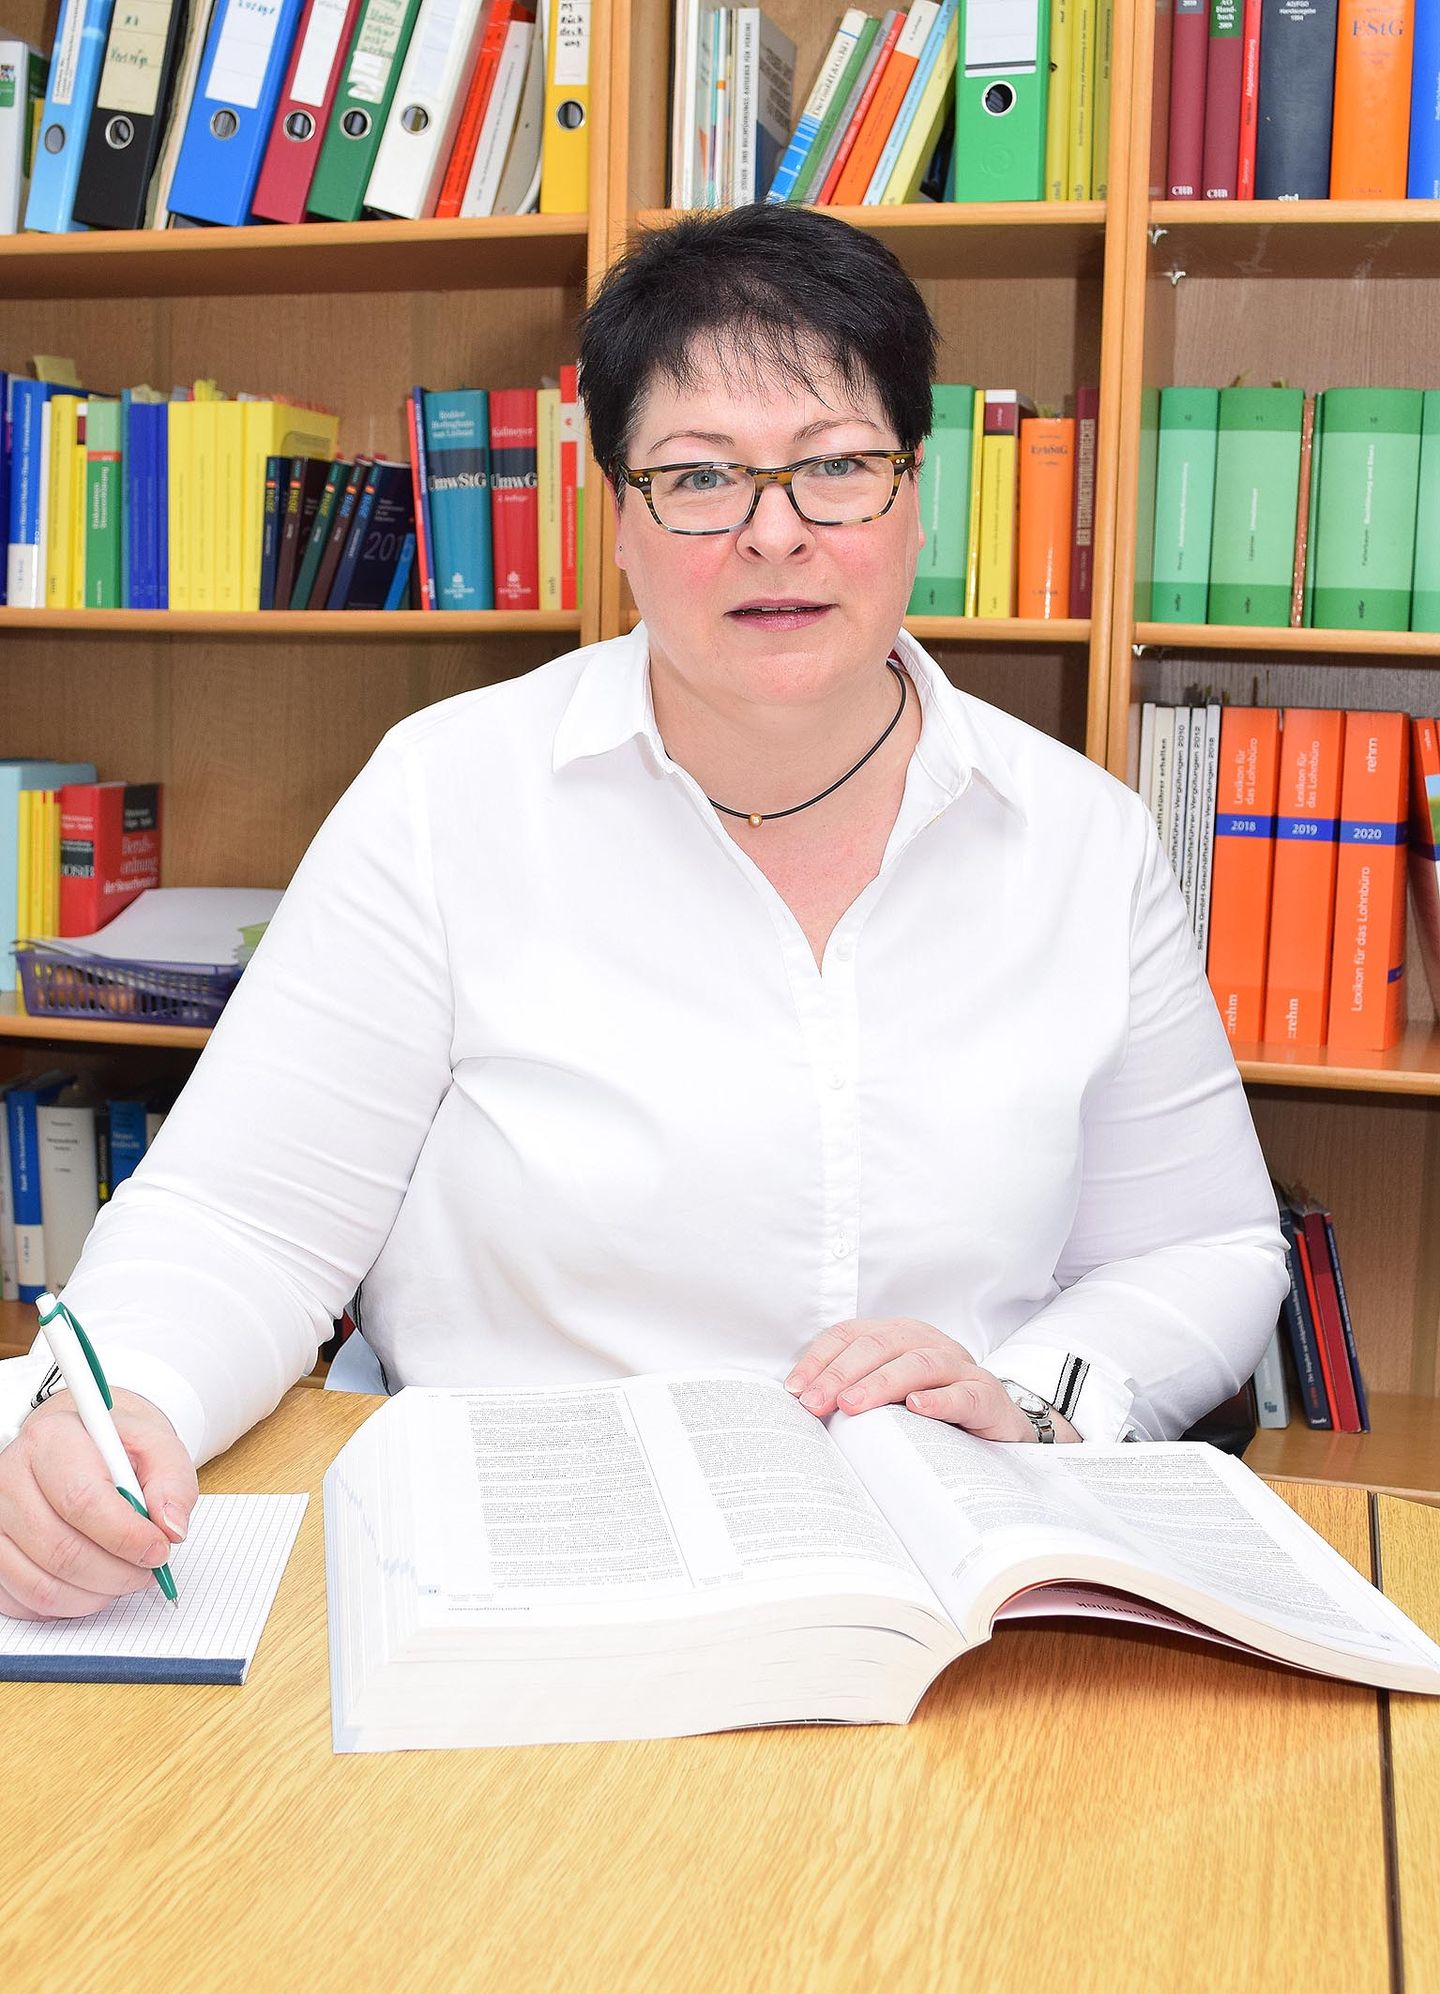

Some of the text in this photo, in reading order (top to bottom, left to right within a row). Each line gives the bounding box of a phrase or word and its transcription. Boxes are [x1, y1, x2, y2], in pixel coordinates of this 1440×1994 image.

[1351, 20, 1404, 36] EStG
[428, 472, 487, 490] UmwStG
[491, 472, 537, 489] UmwG
[1247, 737, 1258, 805] das Lohnbüro
[1366, 737, 1378, 772] rehm
[1234, 750, 1246, 804] Lexikon für
[1295, 752, 1306, 807] Lexikon für
[1307, 740, 1320, 808] das Lohnbüro
[1172, 750, 1184, 873] chäftsführer-Vergütungen
[1231, 820, 1257, 832] 2018
[1291, 823, 1318, 836] 2019
[1353, 828, 1382, 840] 2020
[1351, 866, 1371, 1012] Lexikon für das Lohnbüro
